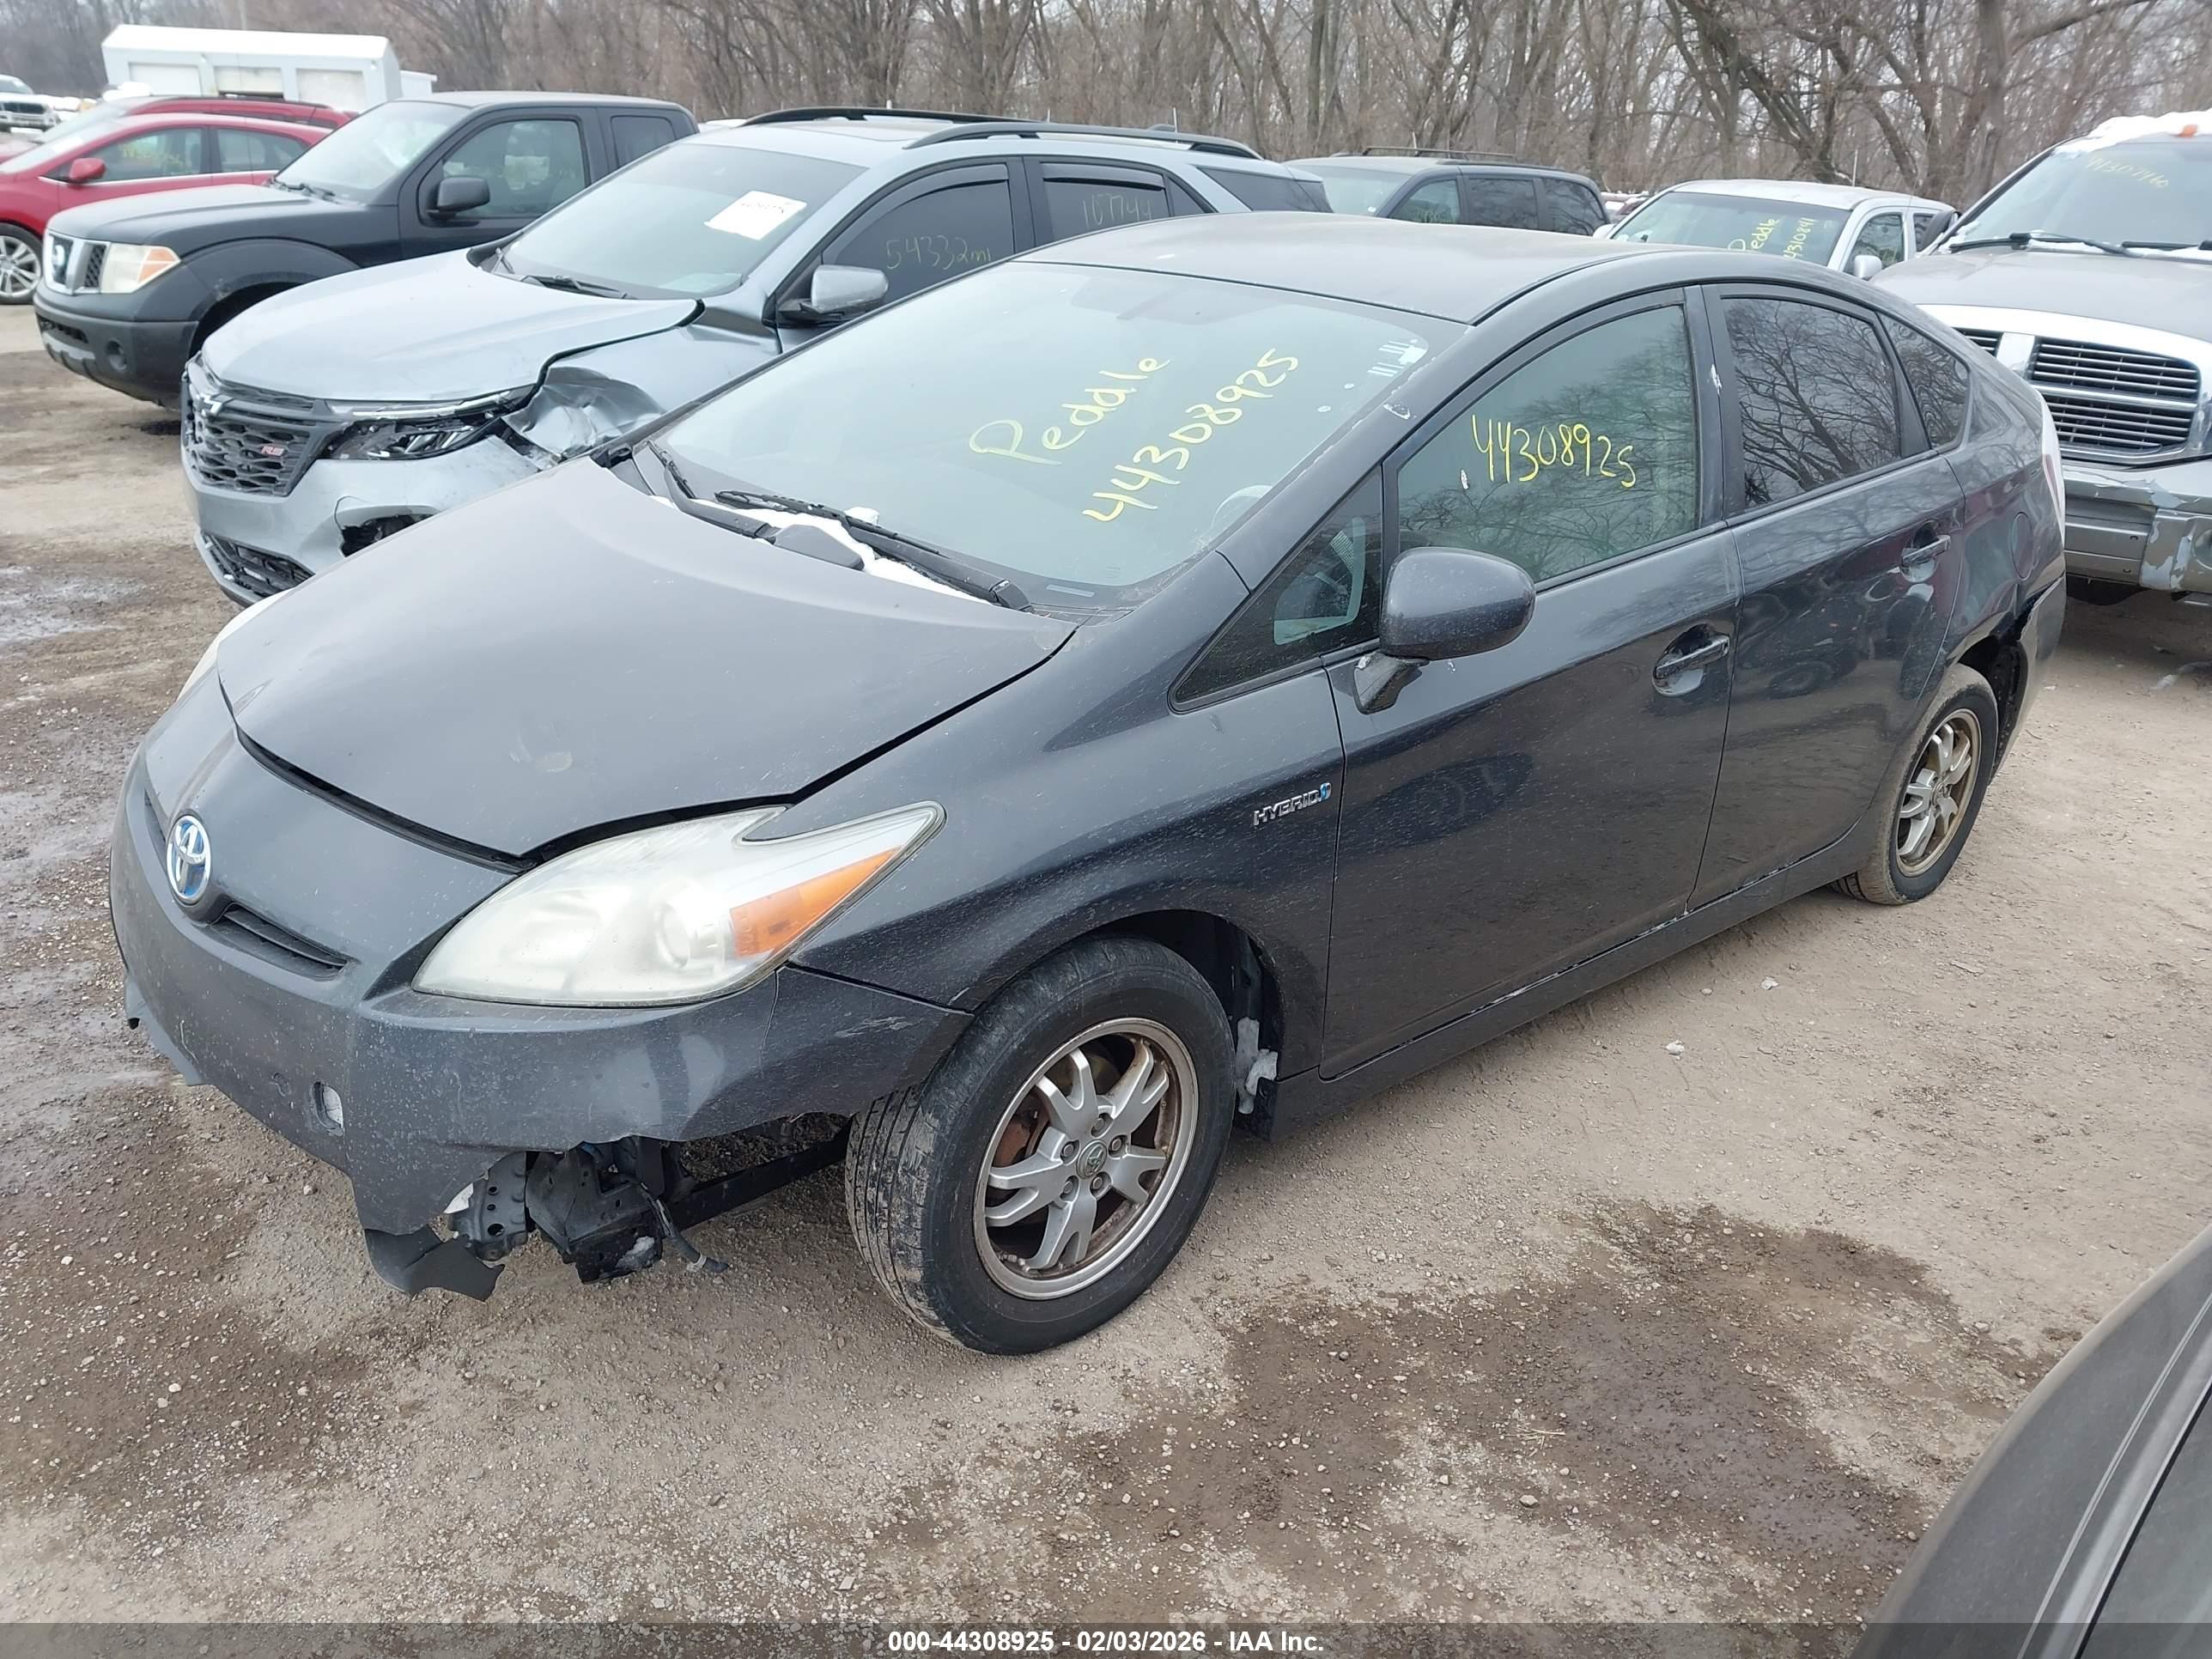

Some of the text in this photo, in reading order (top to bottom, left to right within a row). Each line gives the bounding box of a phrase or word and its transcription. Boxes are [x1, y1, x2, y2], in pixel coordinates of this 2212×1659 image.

[969, 357, 1172, 465] Peddle
[1082, 347, 1299, 522] 44308925
[1472, 414, 1637, 488] 44308925
[1254, 789, 1321, 826] HYBRID
